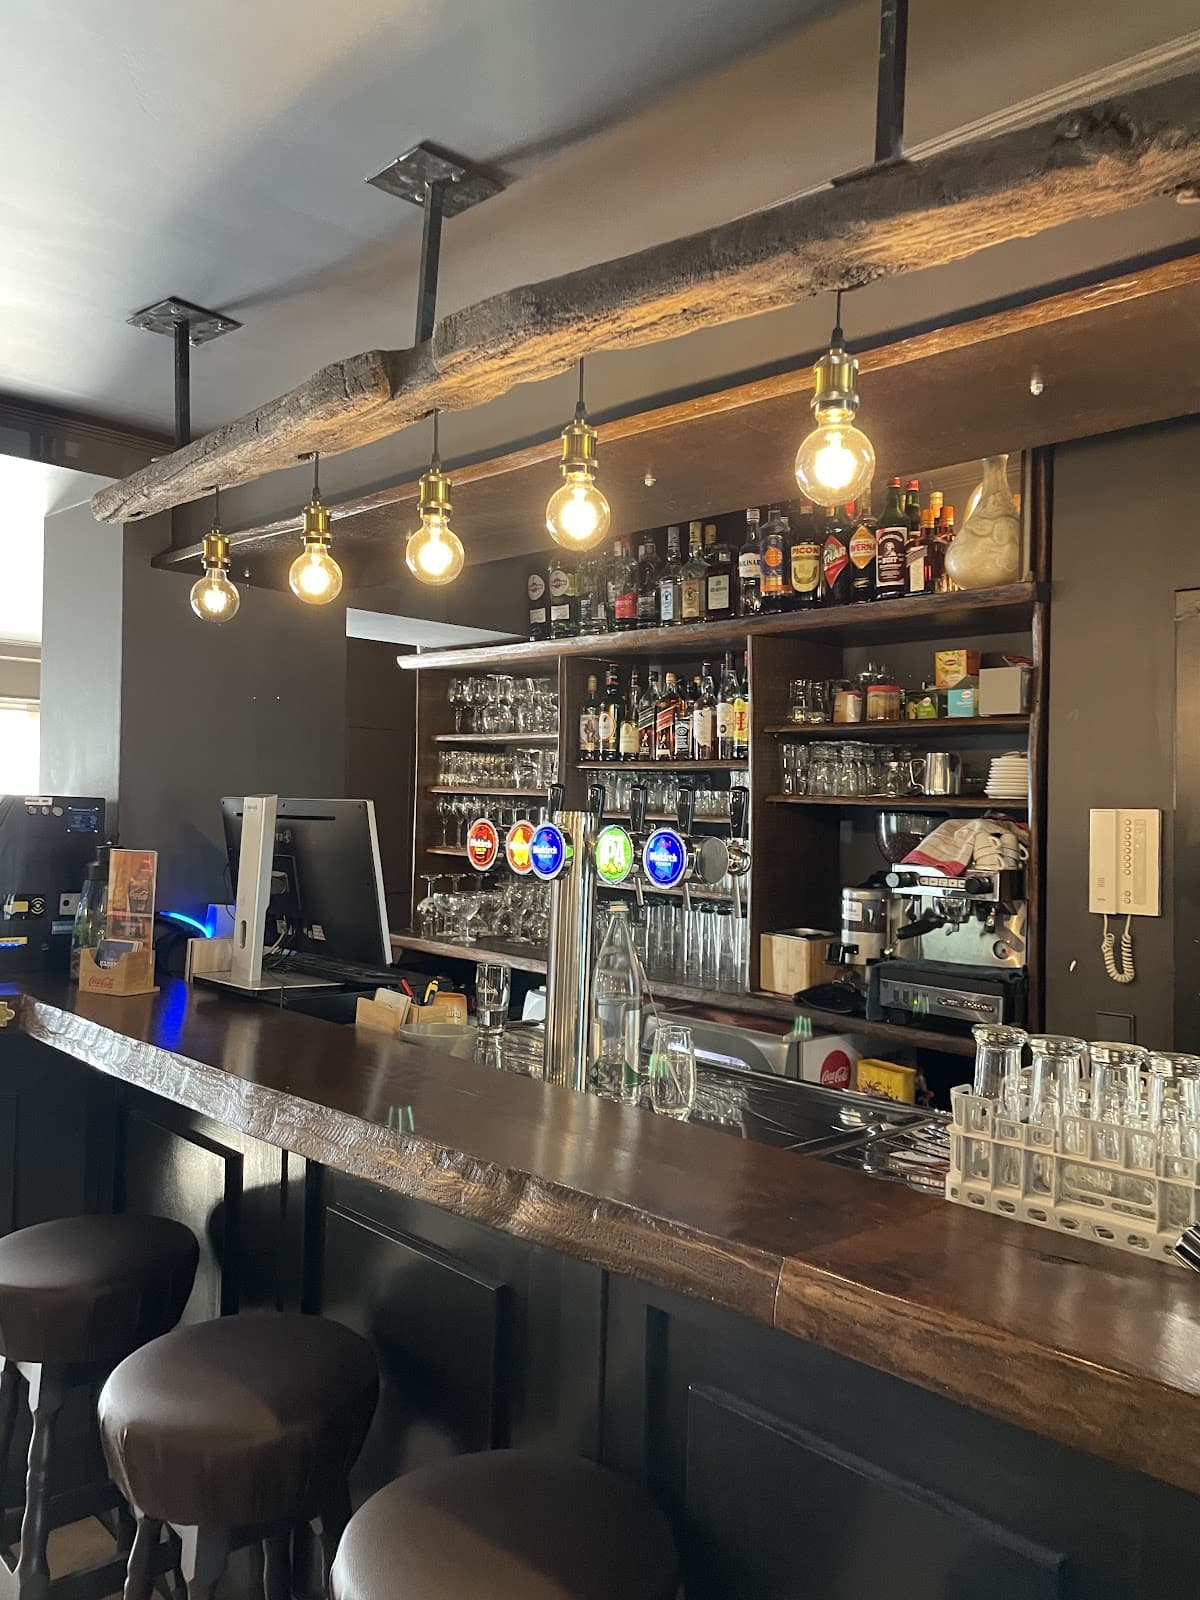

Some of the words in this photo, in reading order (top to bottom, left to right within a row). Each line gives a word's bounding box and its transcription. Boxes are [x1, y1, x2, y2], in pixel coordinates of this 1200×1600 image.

[533, 846, 558, 854] Diekirch
[600, 834, 626, 867] IPA
[649, 851, 678, 862] Diekirch
